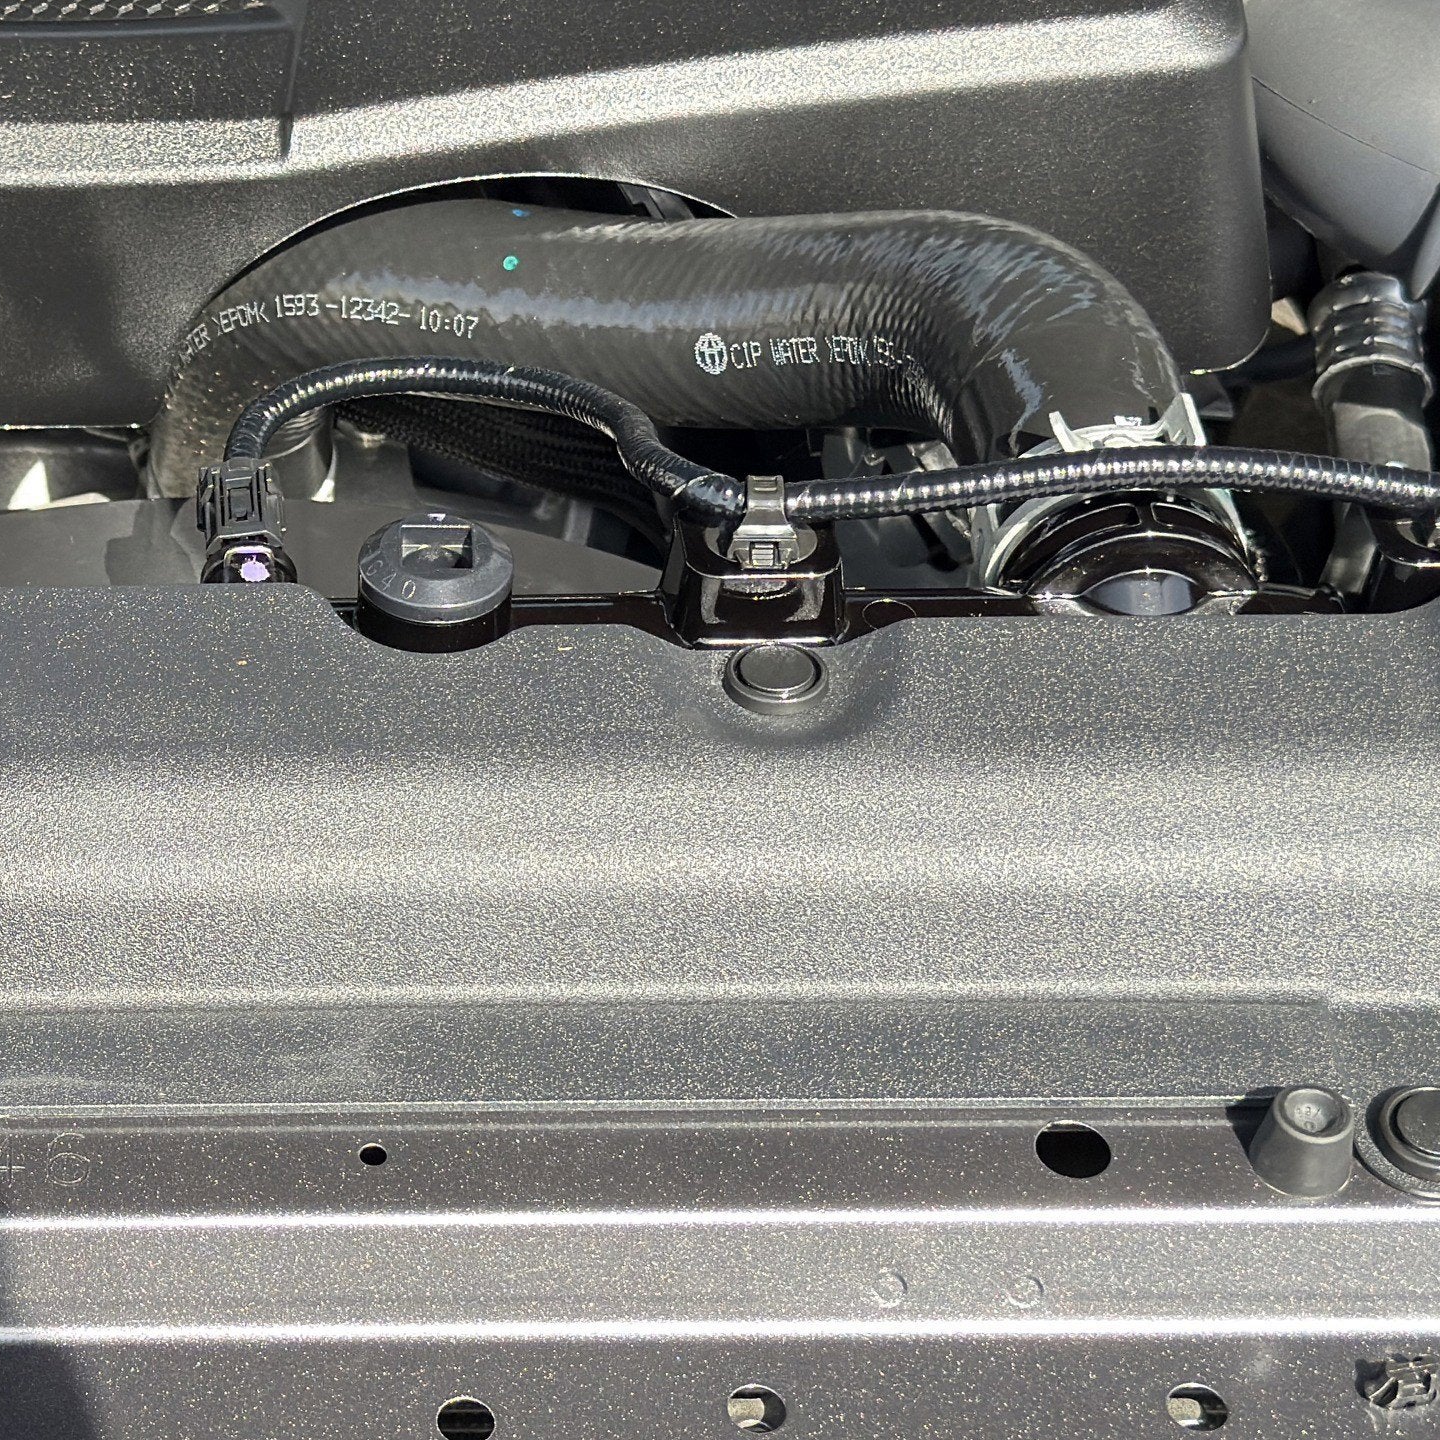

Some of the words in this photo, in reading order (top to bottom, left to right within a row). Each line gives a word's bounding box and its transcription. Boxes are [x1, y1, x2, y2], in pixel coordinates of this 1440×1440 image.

[274, 293, 320, 319] 1593
[419, 306, 479, 339] 10:07
[730, 340, 762, 369] CIP
[769, 335, 820, 367] WATER
